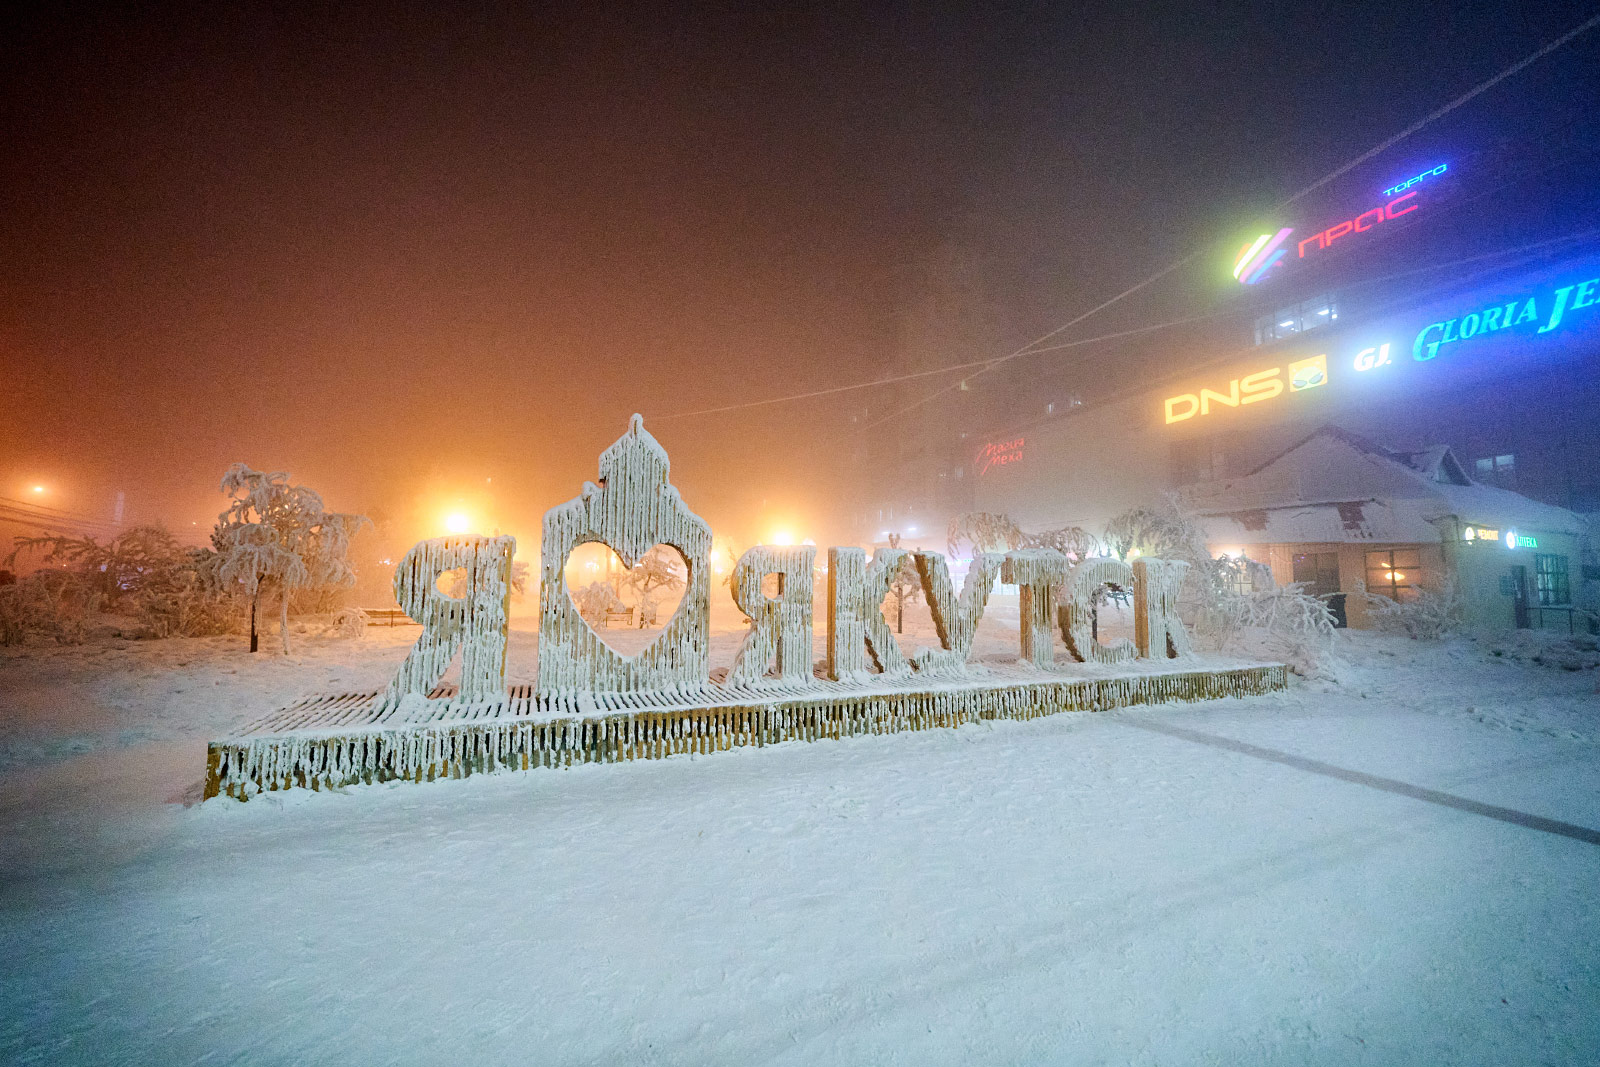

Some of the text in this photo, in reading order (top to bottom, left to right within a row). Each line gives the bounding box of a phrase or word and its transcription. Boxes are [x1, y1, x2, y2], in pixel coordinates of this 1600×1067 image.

[1412, 278, 1600, 362] GLORIA JE
[1165, 367, 1284, 425] DNS
[727, 544, 1193, 686] ЯКУТСК
